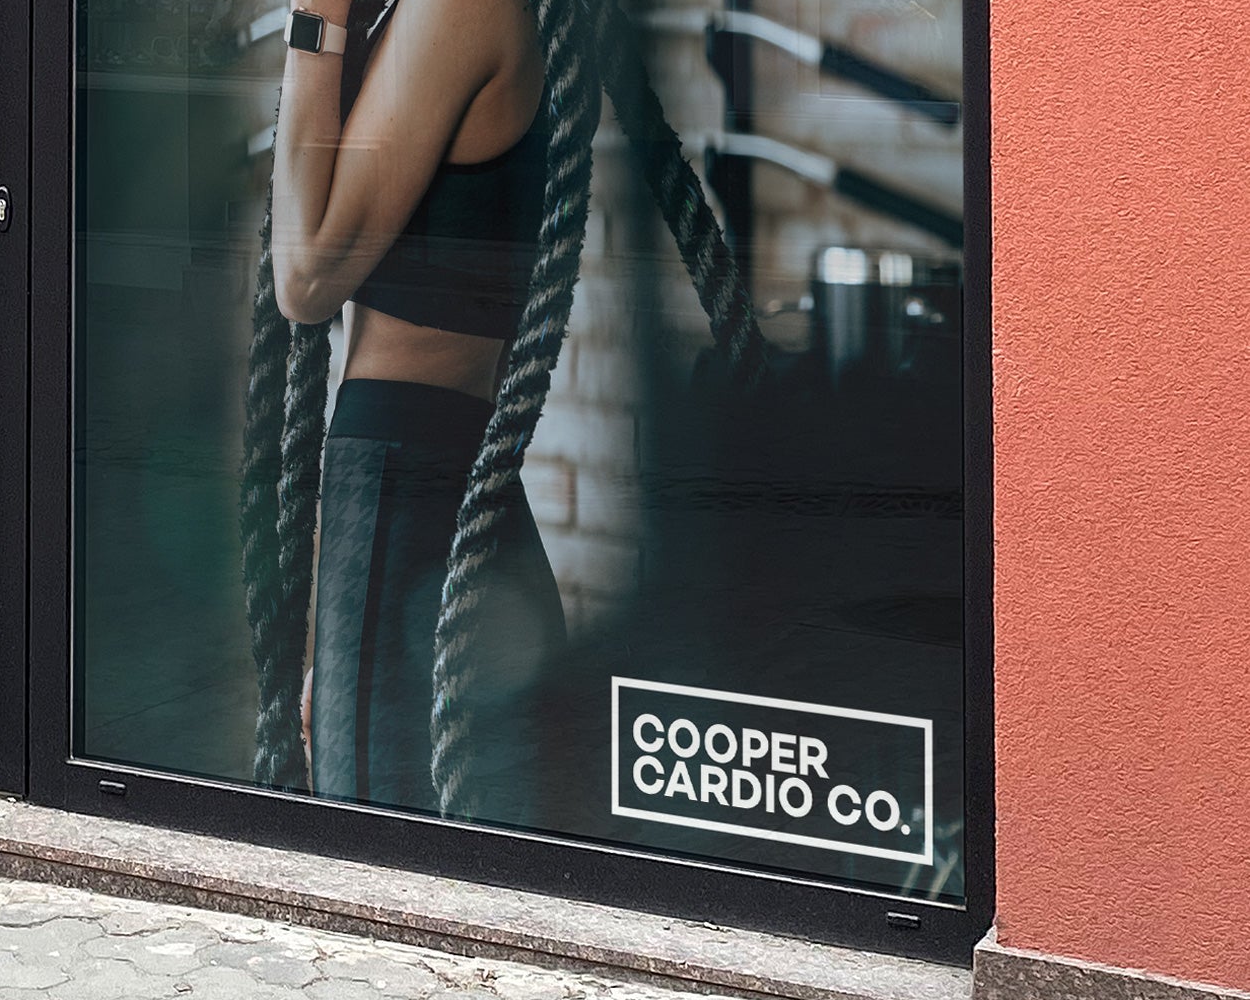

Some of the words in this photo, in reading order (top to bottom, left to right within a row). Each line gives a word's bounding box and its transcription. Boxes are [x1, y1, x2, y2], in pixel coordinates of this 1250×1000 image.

[632, 713, 830, 779] COOPER
[632, 755, 813, 818] CARDIO
[827, 785, 911, 836] CO.
